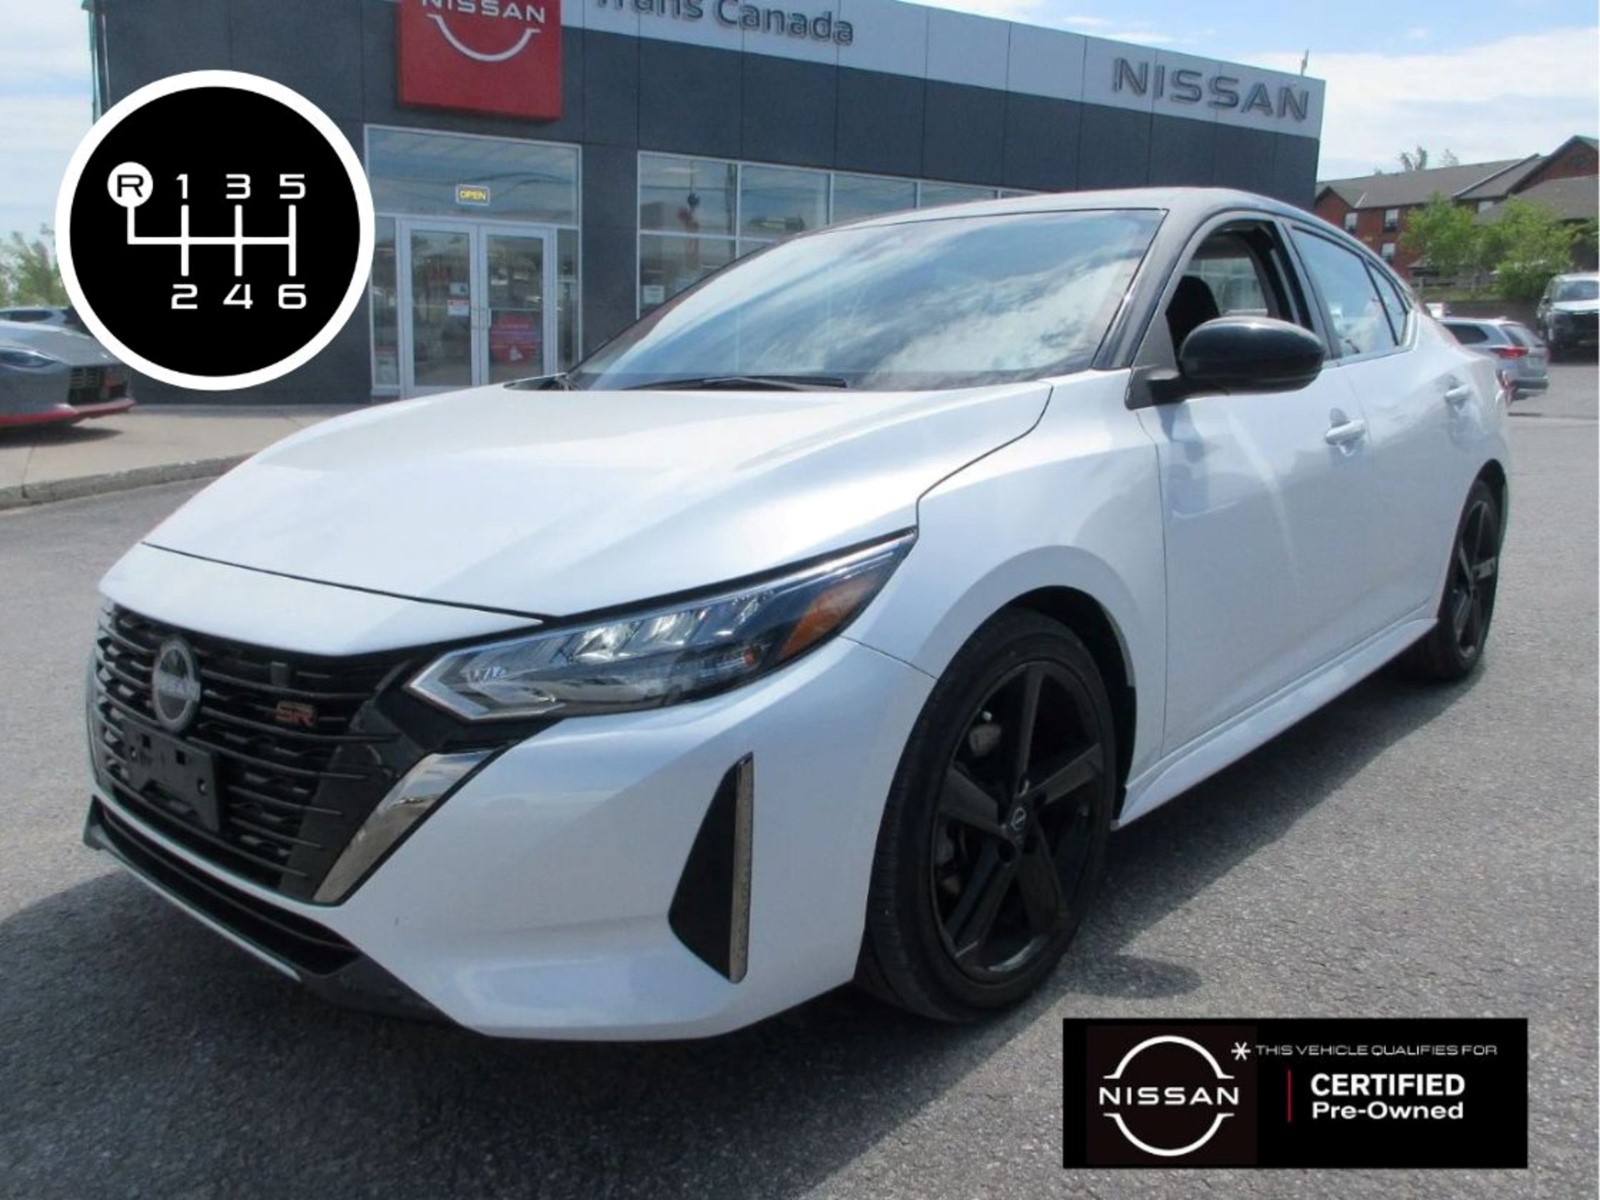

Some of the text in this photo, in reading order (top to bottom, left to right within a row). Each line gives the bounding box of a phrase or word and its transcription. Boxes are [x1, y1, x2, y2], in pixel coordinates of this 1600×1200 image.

[598, 0, 855, 46] ans Canada
[1113, 57, 1310, 122] NISSAN
[460, 190, 487, 201] OPEN
[275, 701, 314, 727] SR
